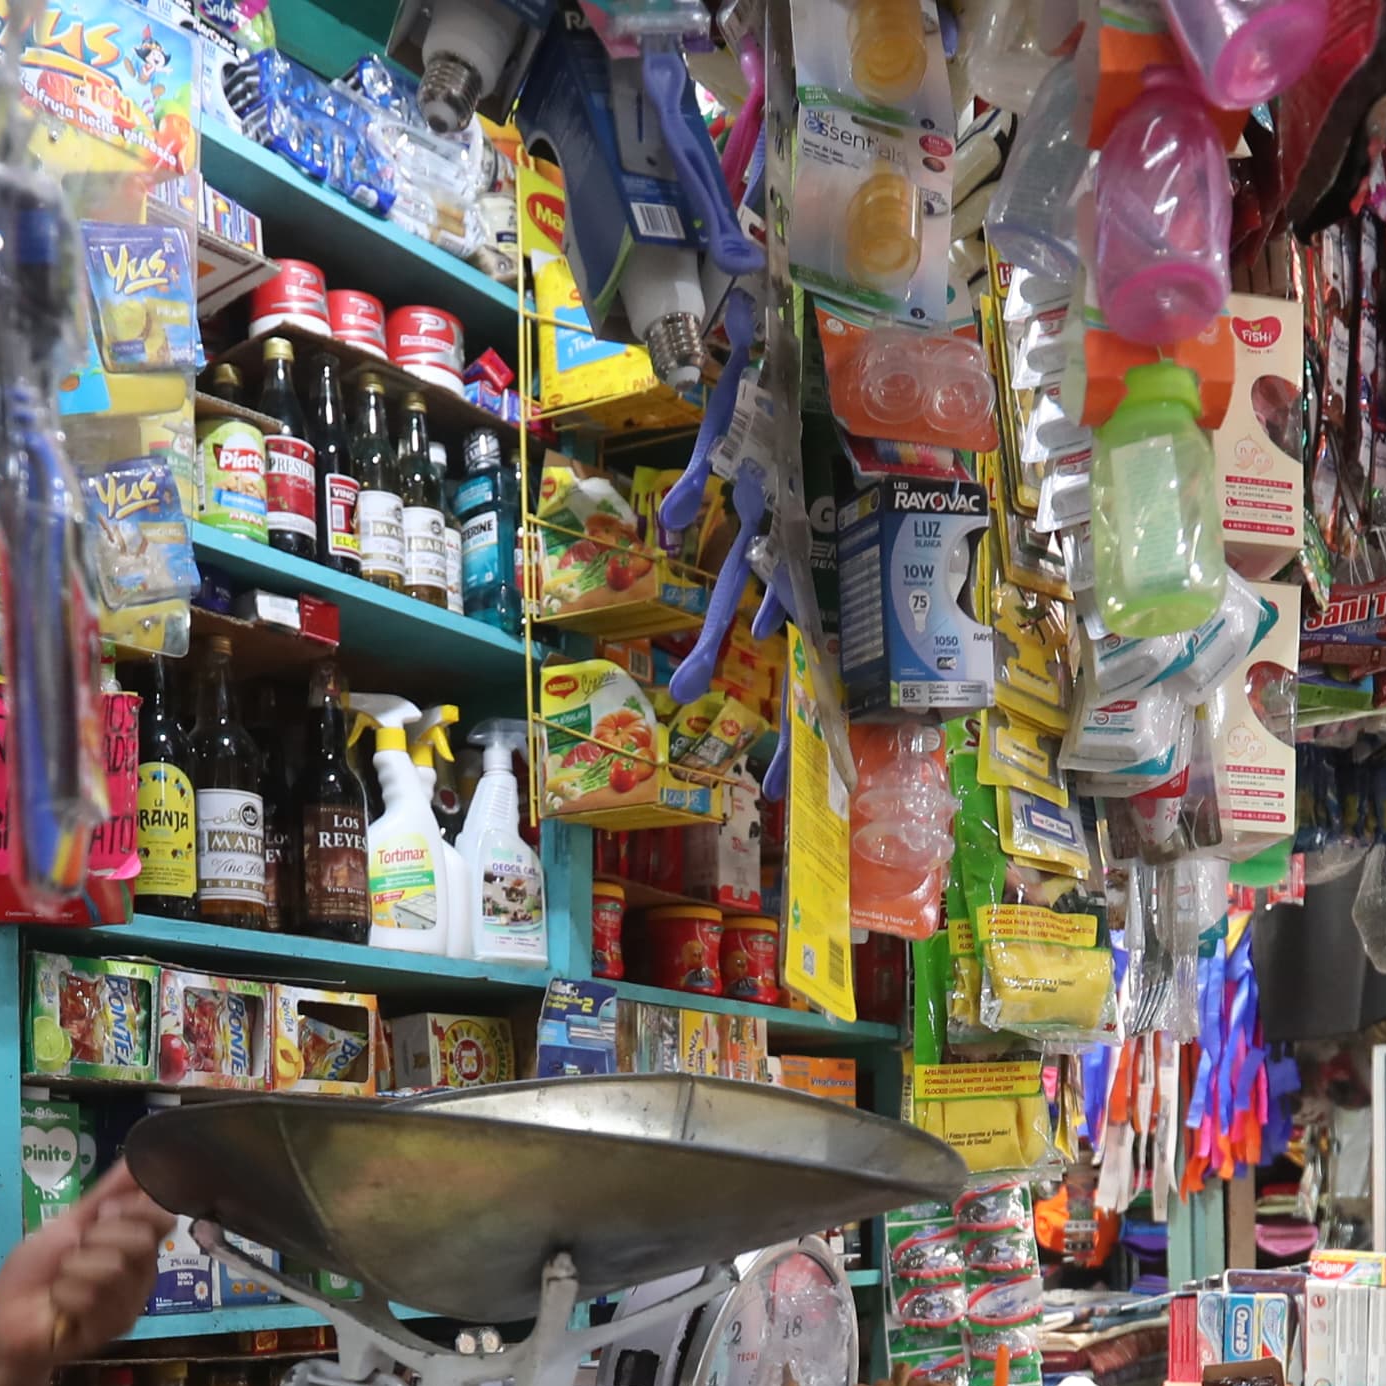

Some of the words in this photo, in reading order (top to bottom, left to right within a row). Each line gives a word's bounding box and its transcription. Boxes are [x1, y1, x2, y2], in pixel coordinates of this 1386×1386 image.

[78, 108, 120, 136] hecha
[102, 243, 169, 295] Yus
[893, 481, 910, 491] LED
[93, 473, 159, 520] Yus
[893, 491, 981, 513] RAYOVAC
[914, 520, 943, 539] LUZ
[915, 540, 943, 549] BLANCA
[903, 564, 935, 579] 10W
[912, 595, 928, 609] 75
[1304, 596, 1370, 632] Sani
[934, 635, 960, 647] 1050
[333, 813, 359, 829] LOS
[317, 831, 369, 851] REYES
[377, 847, 427, 866] Tortimax
[22, 1141, 76, 1164] Pinito
[1312, 1260, 1347, 1279] Colgate
[1230, 1304, 1248, 1357] Oral-B
